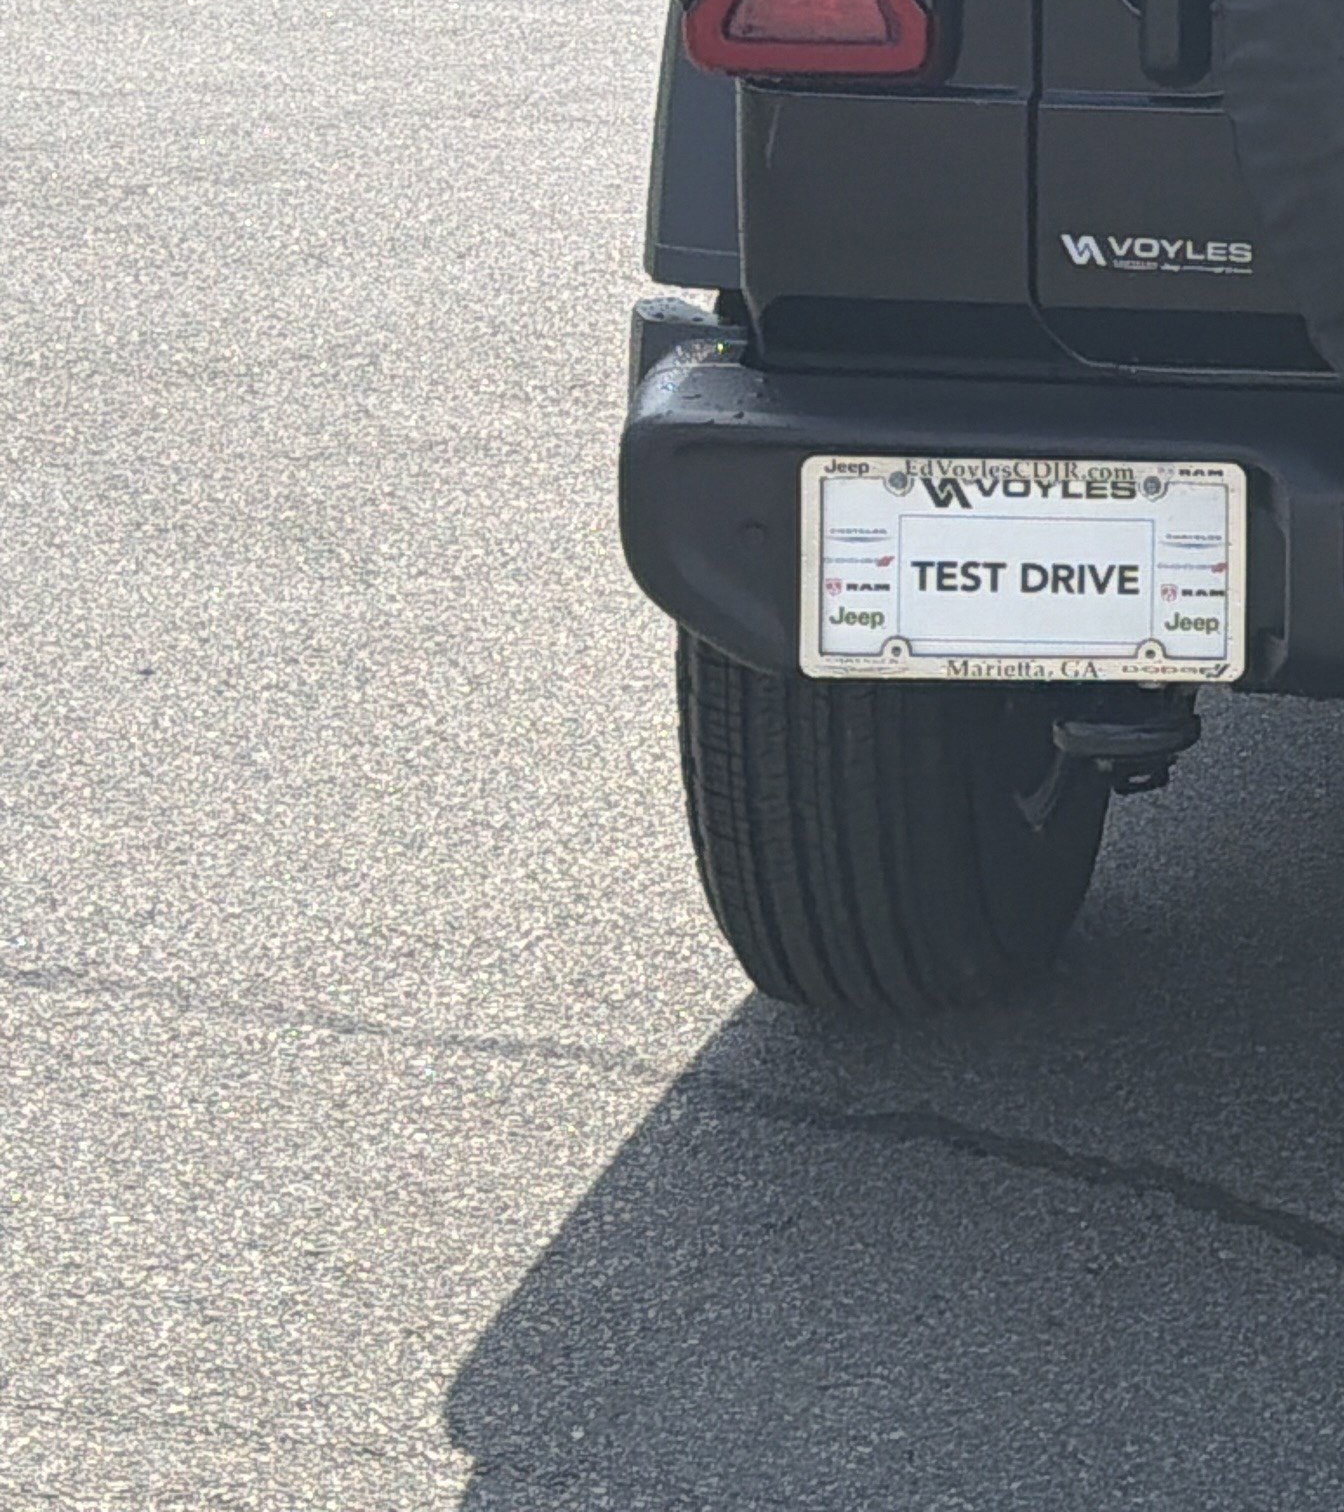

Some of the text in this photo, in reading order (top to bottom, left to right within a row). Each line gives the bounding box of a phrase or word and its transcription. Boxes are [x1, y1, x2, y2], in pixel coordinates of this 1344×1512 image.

[1107, 235, 1252, 263] VOYLES
[824, 459, 870, 476] Jeep
[975, 478, 1137, 499] VOYLES
[911, 561, 1140, 596] TEST DRIVE
[829, 606, 885, 629] Jeep
[1164, 611, 1219, 634] Jeep
[947, 659, 1099, 679] Marietta, GA
